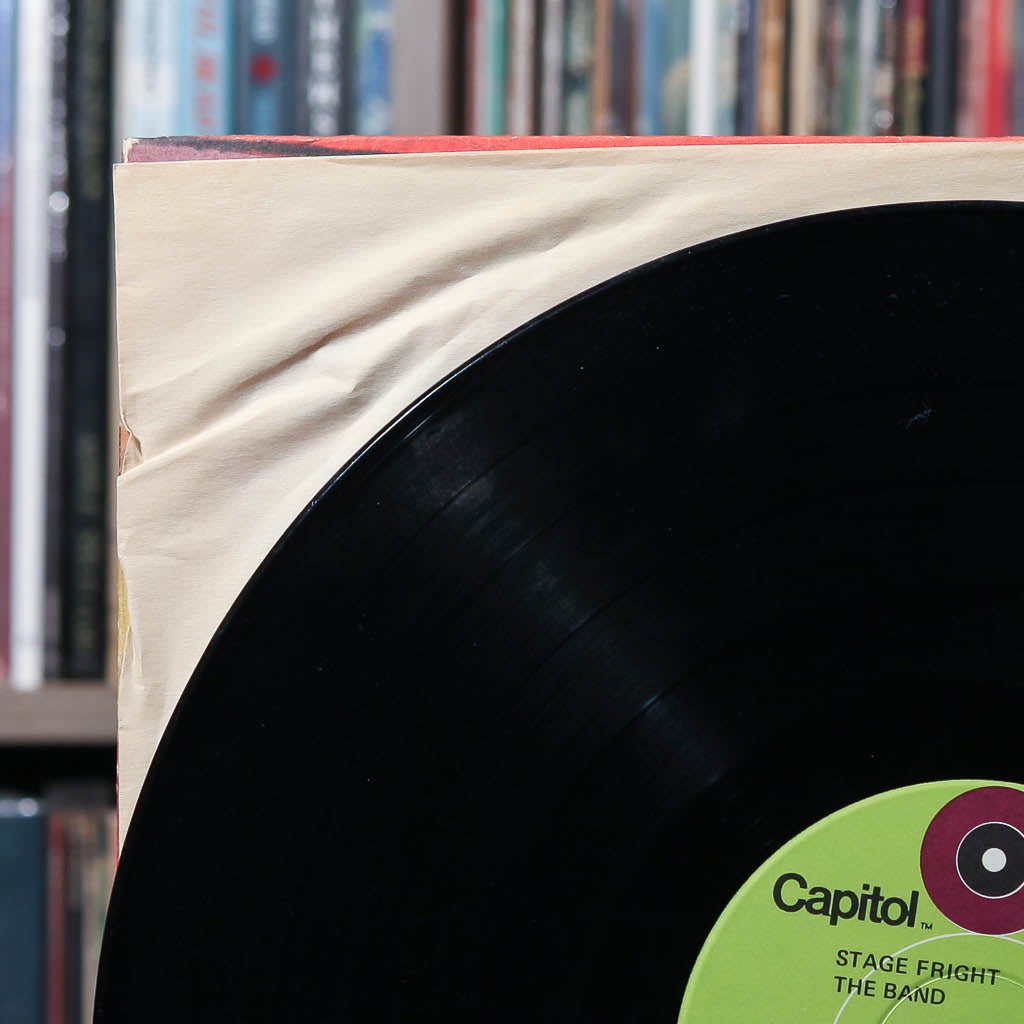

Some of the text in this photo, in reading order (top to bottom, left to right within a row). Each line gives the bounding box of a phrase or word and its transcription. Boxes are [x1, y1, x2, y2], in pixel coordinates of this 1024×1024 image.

[772, 872, 920, 928] Capitol
[835, 949, 1001, 985] STAGE FRIGHT
[834, 975, 946, 1005] THE BAND
